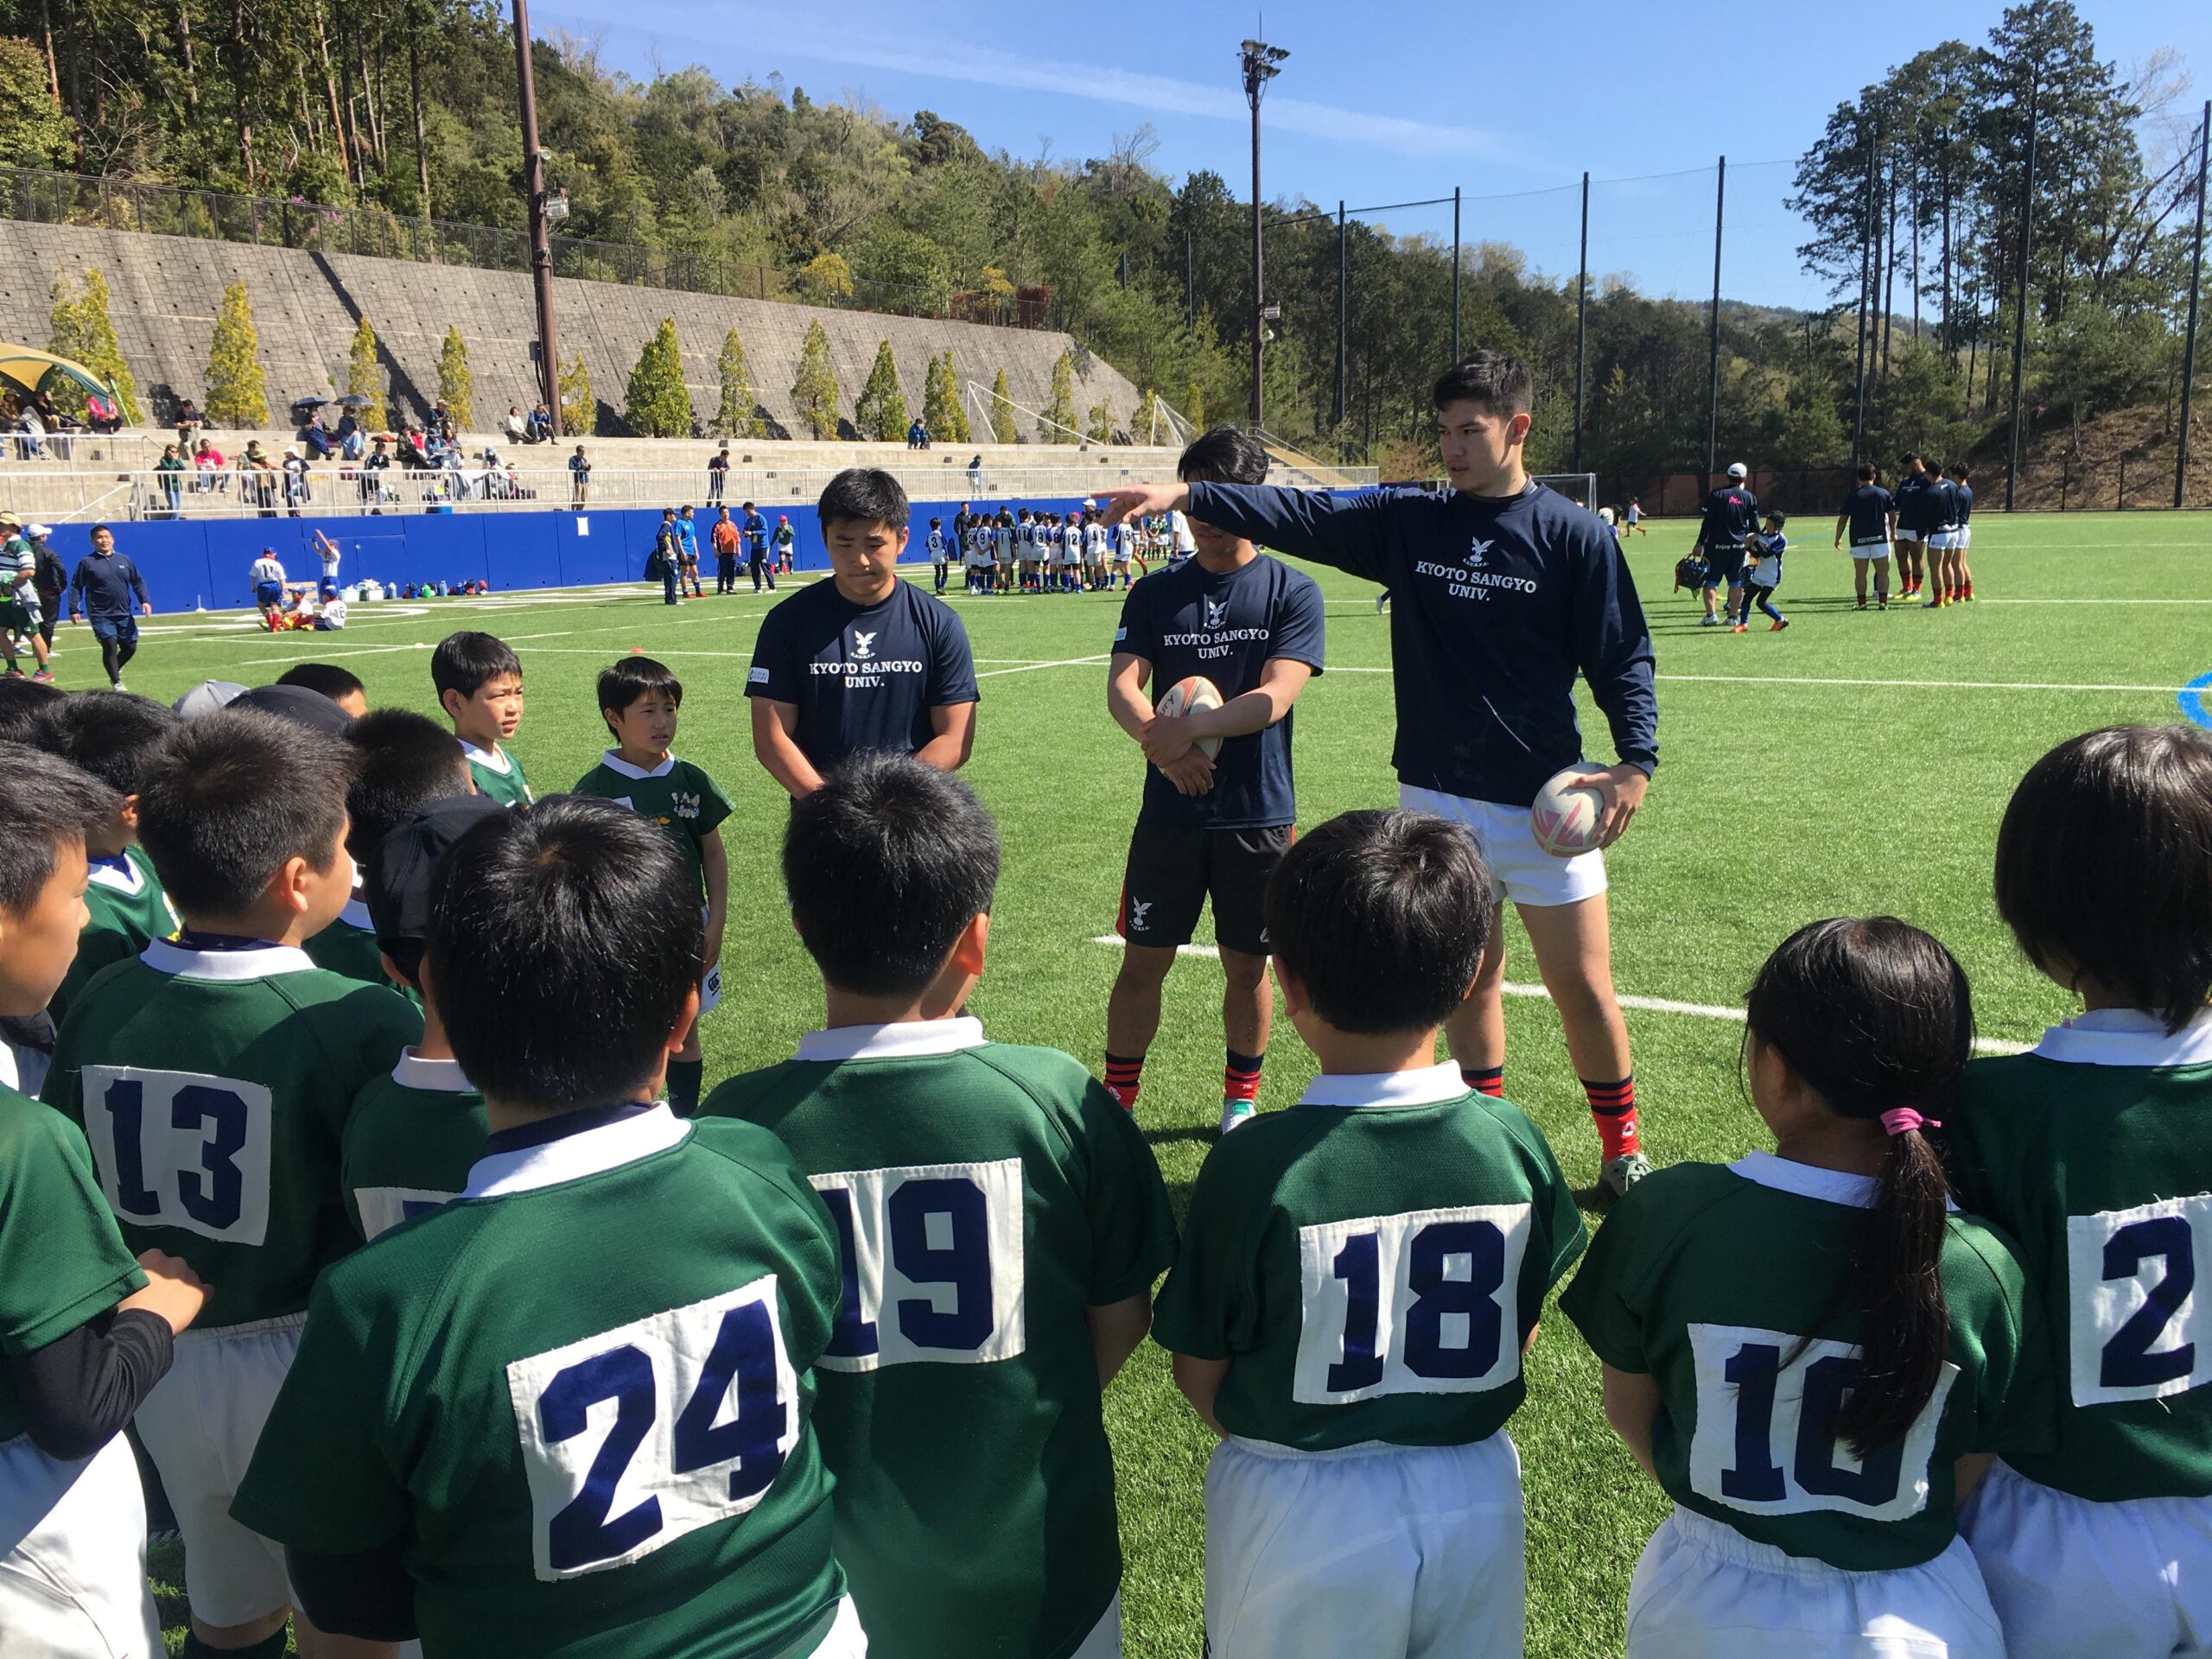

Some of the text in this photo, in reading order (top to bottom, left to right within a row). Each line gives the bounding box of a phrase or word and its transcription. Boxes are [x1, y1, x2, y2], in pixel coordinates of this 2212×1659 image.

[931, 536, 938, 549] 3
[980, 532, 986, 544] 9
[1067, 533, 1078, 545] 12
[1415, 560, 1537, 594] KYOTO SANGYO
[1448, 583, 1491, 601] UNIV.
[1163, 628, 1269, 646] KYOTO SANGYO
[1198, 645, 1233, 659] UNIV.
[809, 660, 923, 675] KYOTO SANGYO
[844, 676, 885, 688] UNIV.
[104, 1078, 248, 1230] 13
[813, 1177, 995, 1357] 19
[1326, 1220, 1505, 1393] 18
[2100, 1216, 2196, 1388] 2
[537, 1298, 788, 1570] 24
